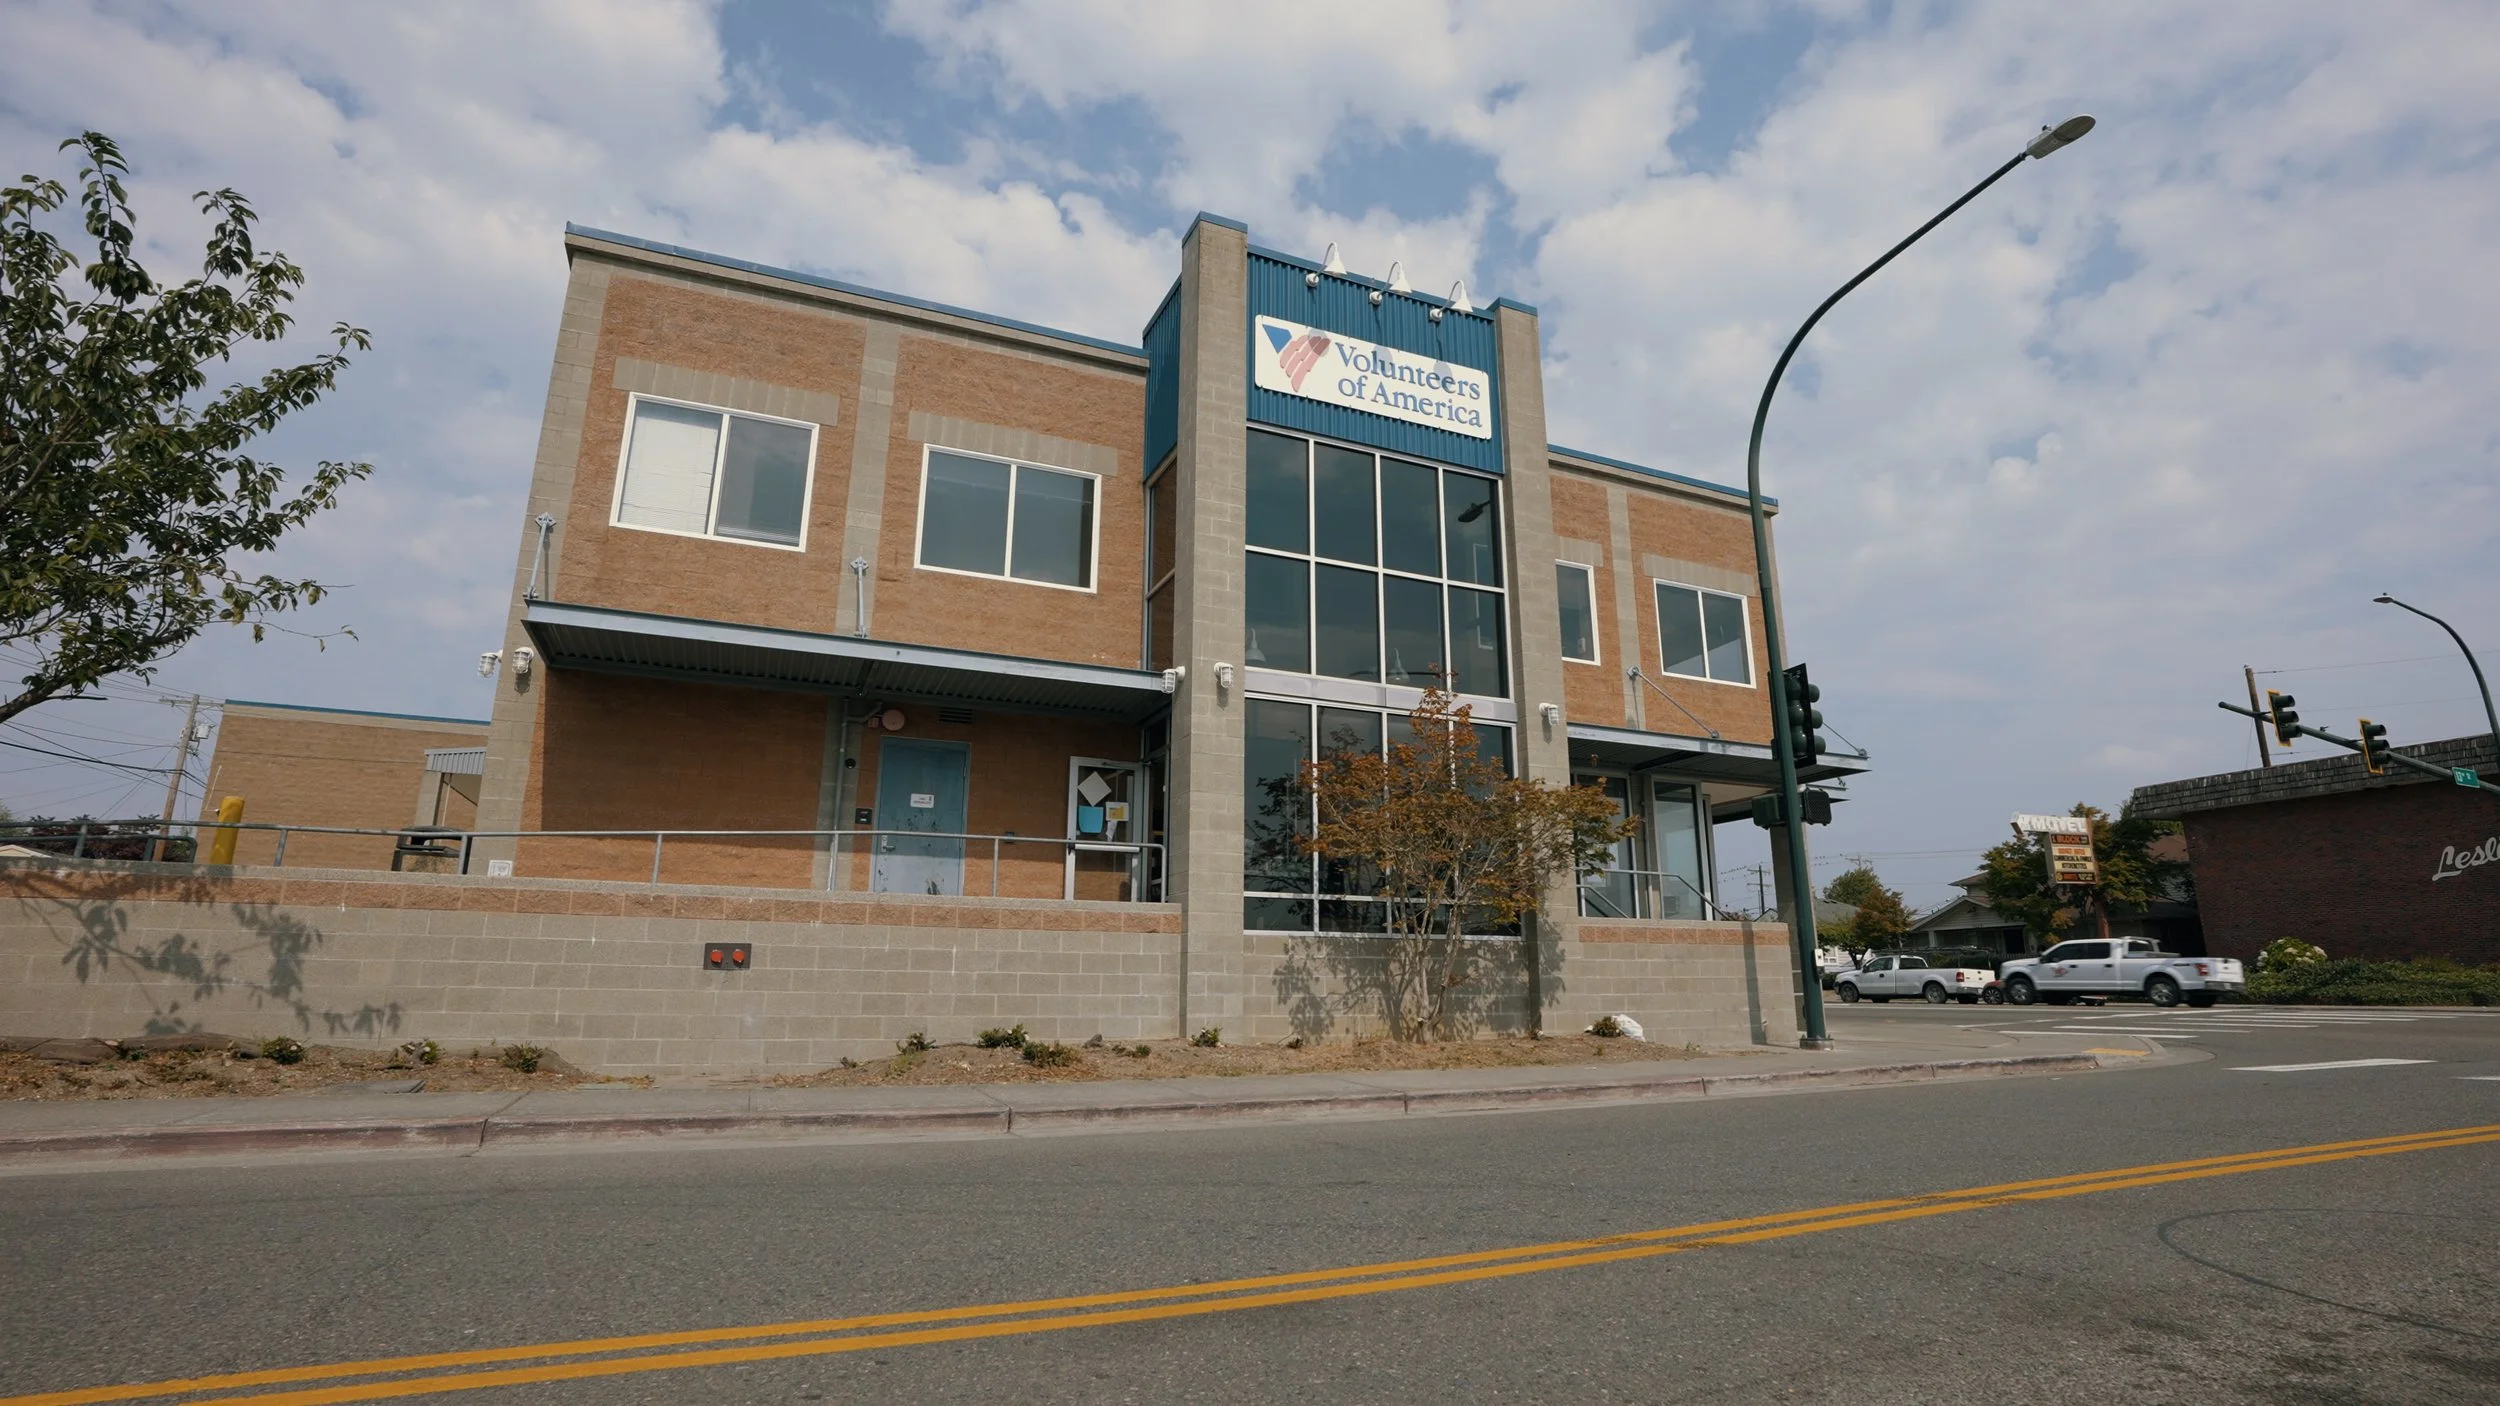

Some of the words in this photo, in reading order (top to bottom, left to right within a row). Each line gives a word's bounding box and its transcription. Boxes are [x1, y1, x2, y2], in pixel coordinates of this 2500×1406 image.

[1335, 342, 1481, 400] Volunteers
[1338, 375, 1367, 400] of
[1370, 381, 1482, 428] America
[2032, 816, 2086, 832] MOTEL
[2056, 835, 2081, 844] BLOCK
[2431, 837, 2500, 881] Lesl
